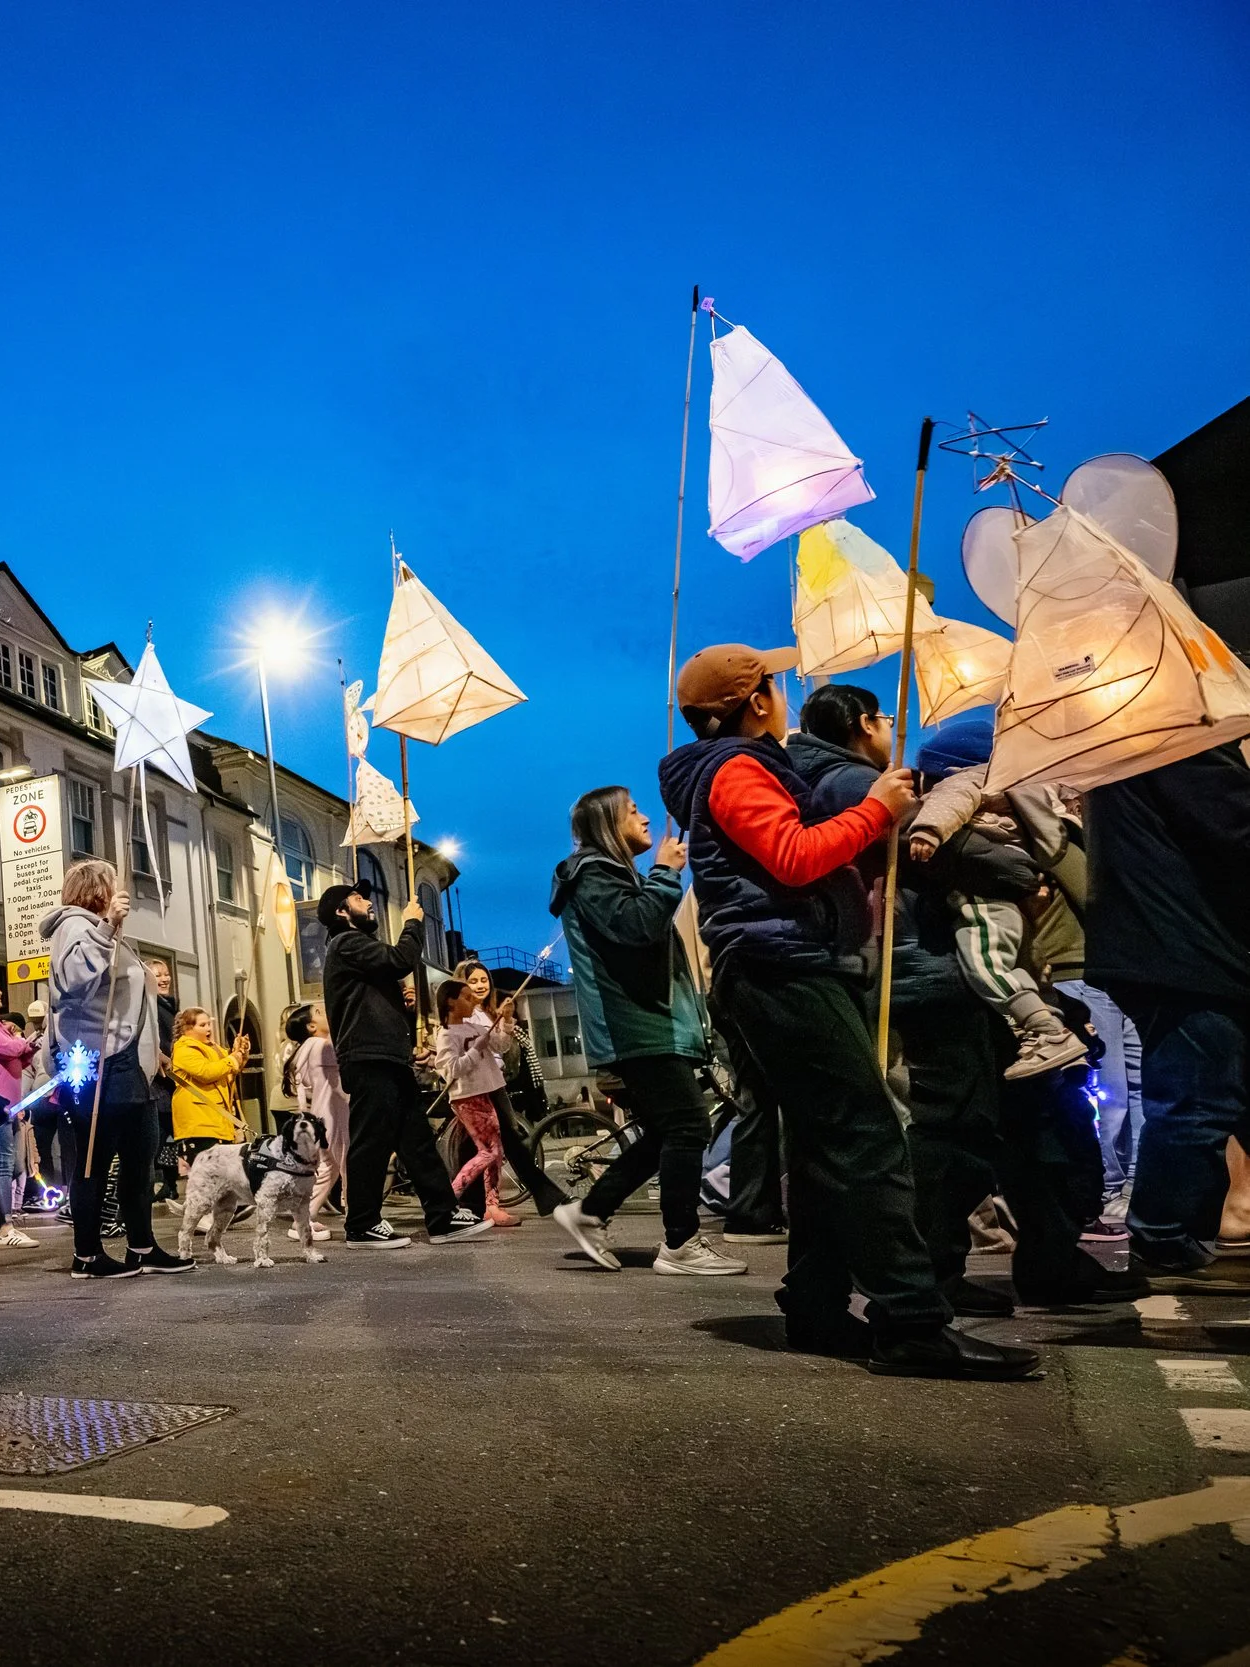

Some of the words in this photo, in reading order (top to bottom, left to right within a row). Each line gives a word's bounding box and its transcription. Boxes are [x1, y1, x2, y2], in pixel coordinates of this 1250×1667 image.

[13, 789, 45, 805] ZONE
[24, 844, 51, 855] vehicles
[15, 861, 38, 871] Except
[16, 871, 35, 879] buses
[13, 878, 31, 888] pedal
[32, 874, 53, 883] cycles
[26, 884, 42, 893] taxis
[7, 895, 32, 904] 7.00pm
[20, 913, 35, 921] Mon
[8, 922, 33, 932] 9.30am
[8, 930, 34, 939] 6.00pm
[22, 938, 34, 947] Sat
